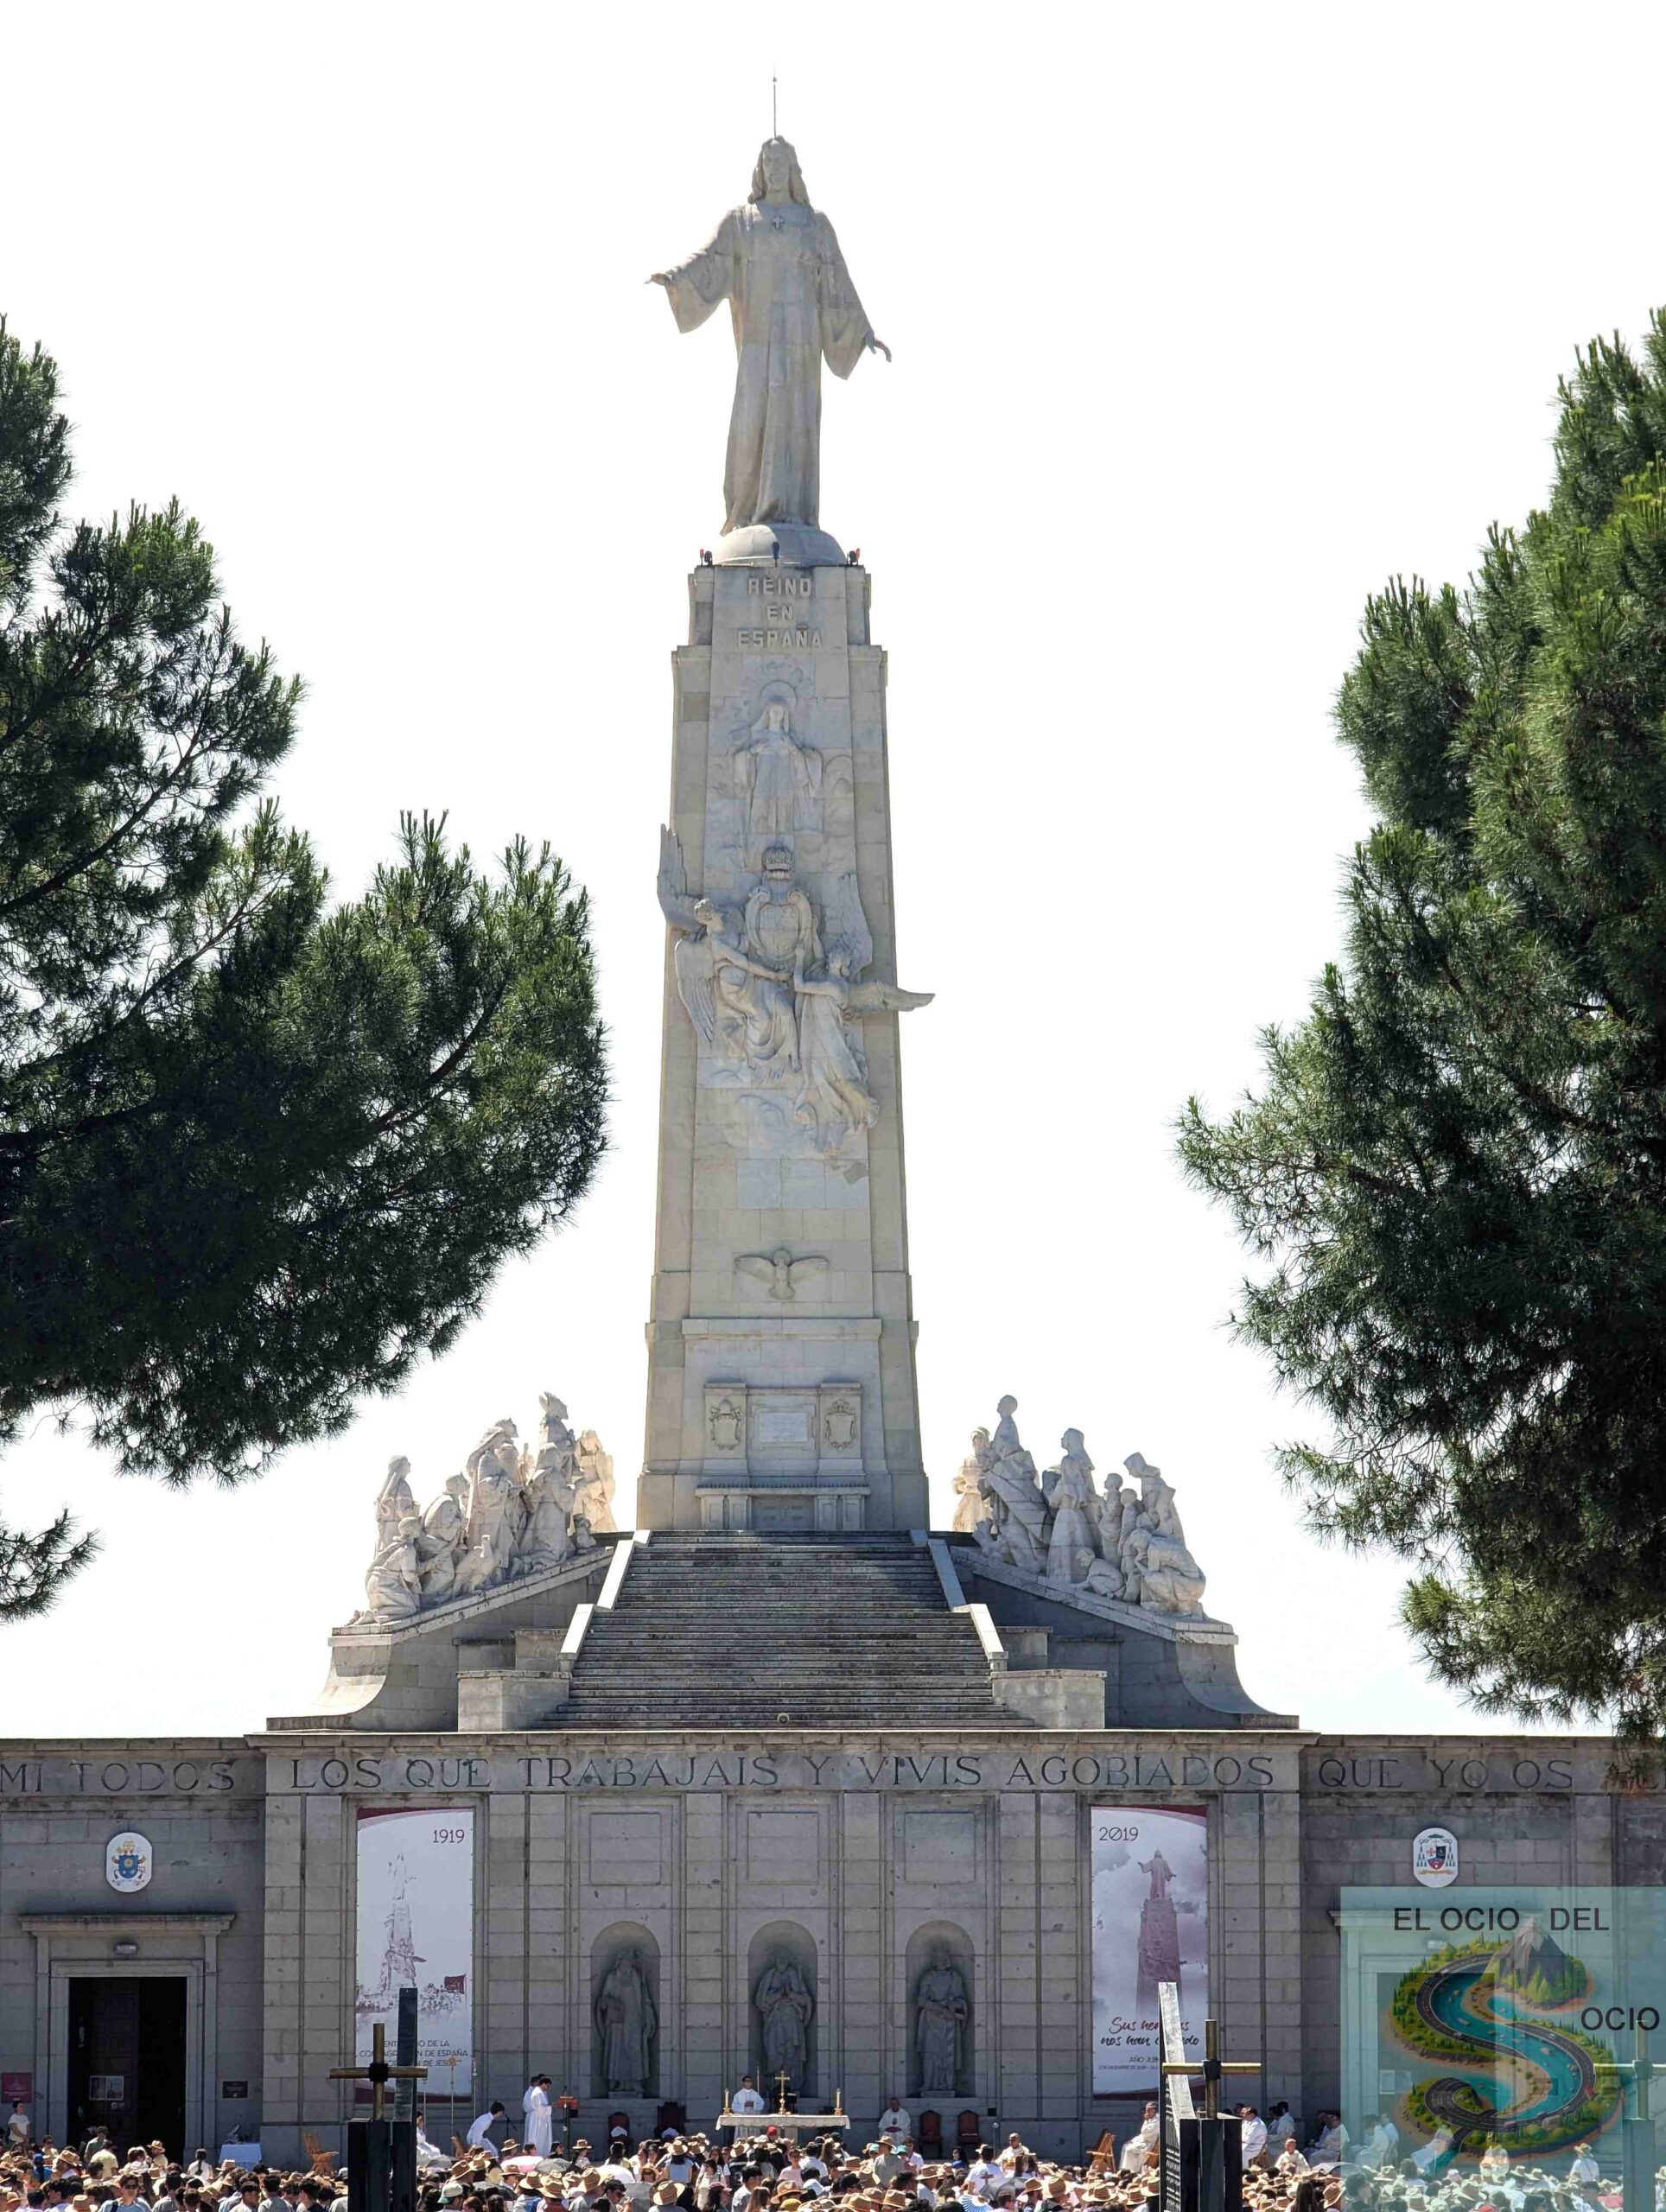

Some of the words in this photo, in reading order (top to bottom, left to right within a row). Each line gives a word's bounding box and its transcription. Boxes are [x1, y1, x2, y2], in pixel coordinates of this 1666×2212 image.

[747, 577, 812, 596] REINO
[766, 605, 793, 621] EN
[737, 625, 823, 648] ESPAÑA
[0, 1763, 43, 1792] MI
[69, 1761, 235, 1792] TODOS
[290, 1759, 382, 1788] LOS
[405, 1758, 491, 1788] QUE
[517, 1757, 778, 1787] TRABAJAIS
[802, 1757, 830, 1785] Y
[857, 1757, 982, 1785] VIVIS
[1006, 1757, 1274, 1786] AGOBIADOS
[1319, 1759, 1403, 1789] QUE
[1425, 1759, 1489, 1789] YO
[1513, 1759, 1574, 1789] OS
[433, 1829, 465, 1843] 1919
[1099, 1827, 1138, 1841] 2019
[1109, 2017, 1136, 2034] Sus
[1101, 2036, 1121, 2046] nos
[1126, 2035, 1150, 2047] han
